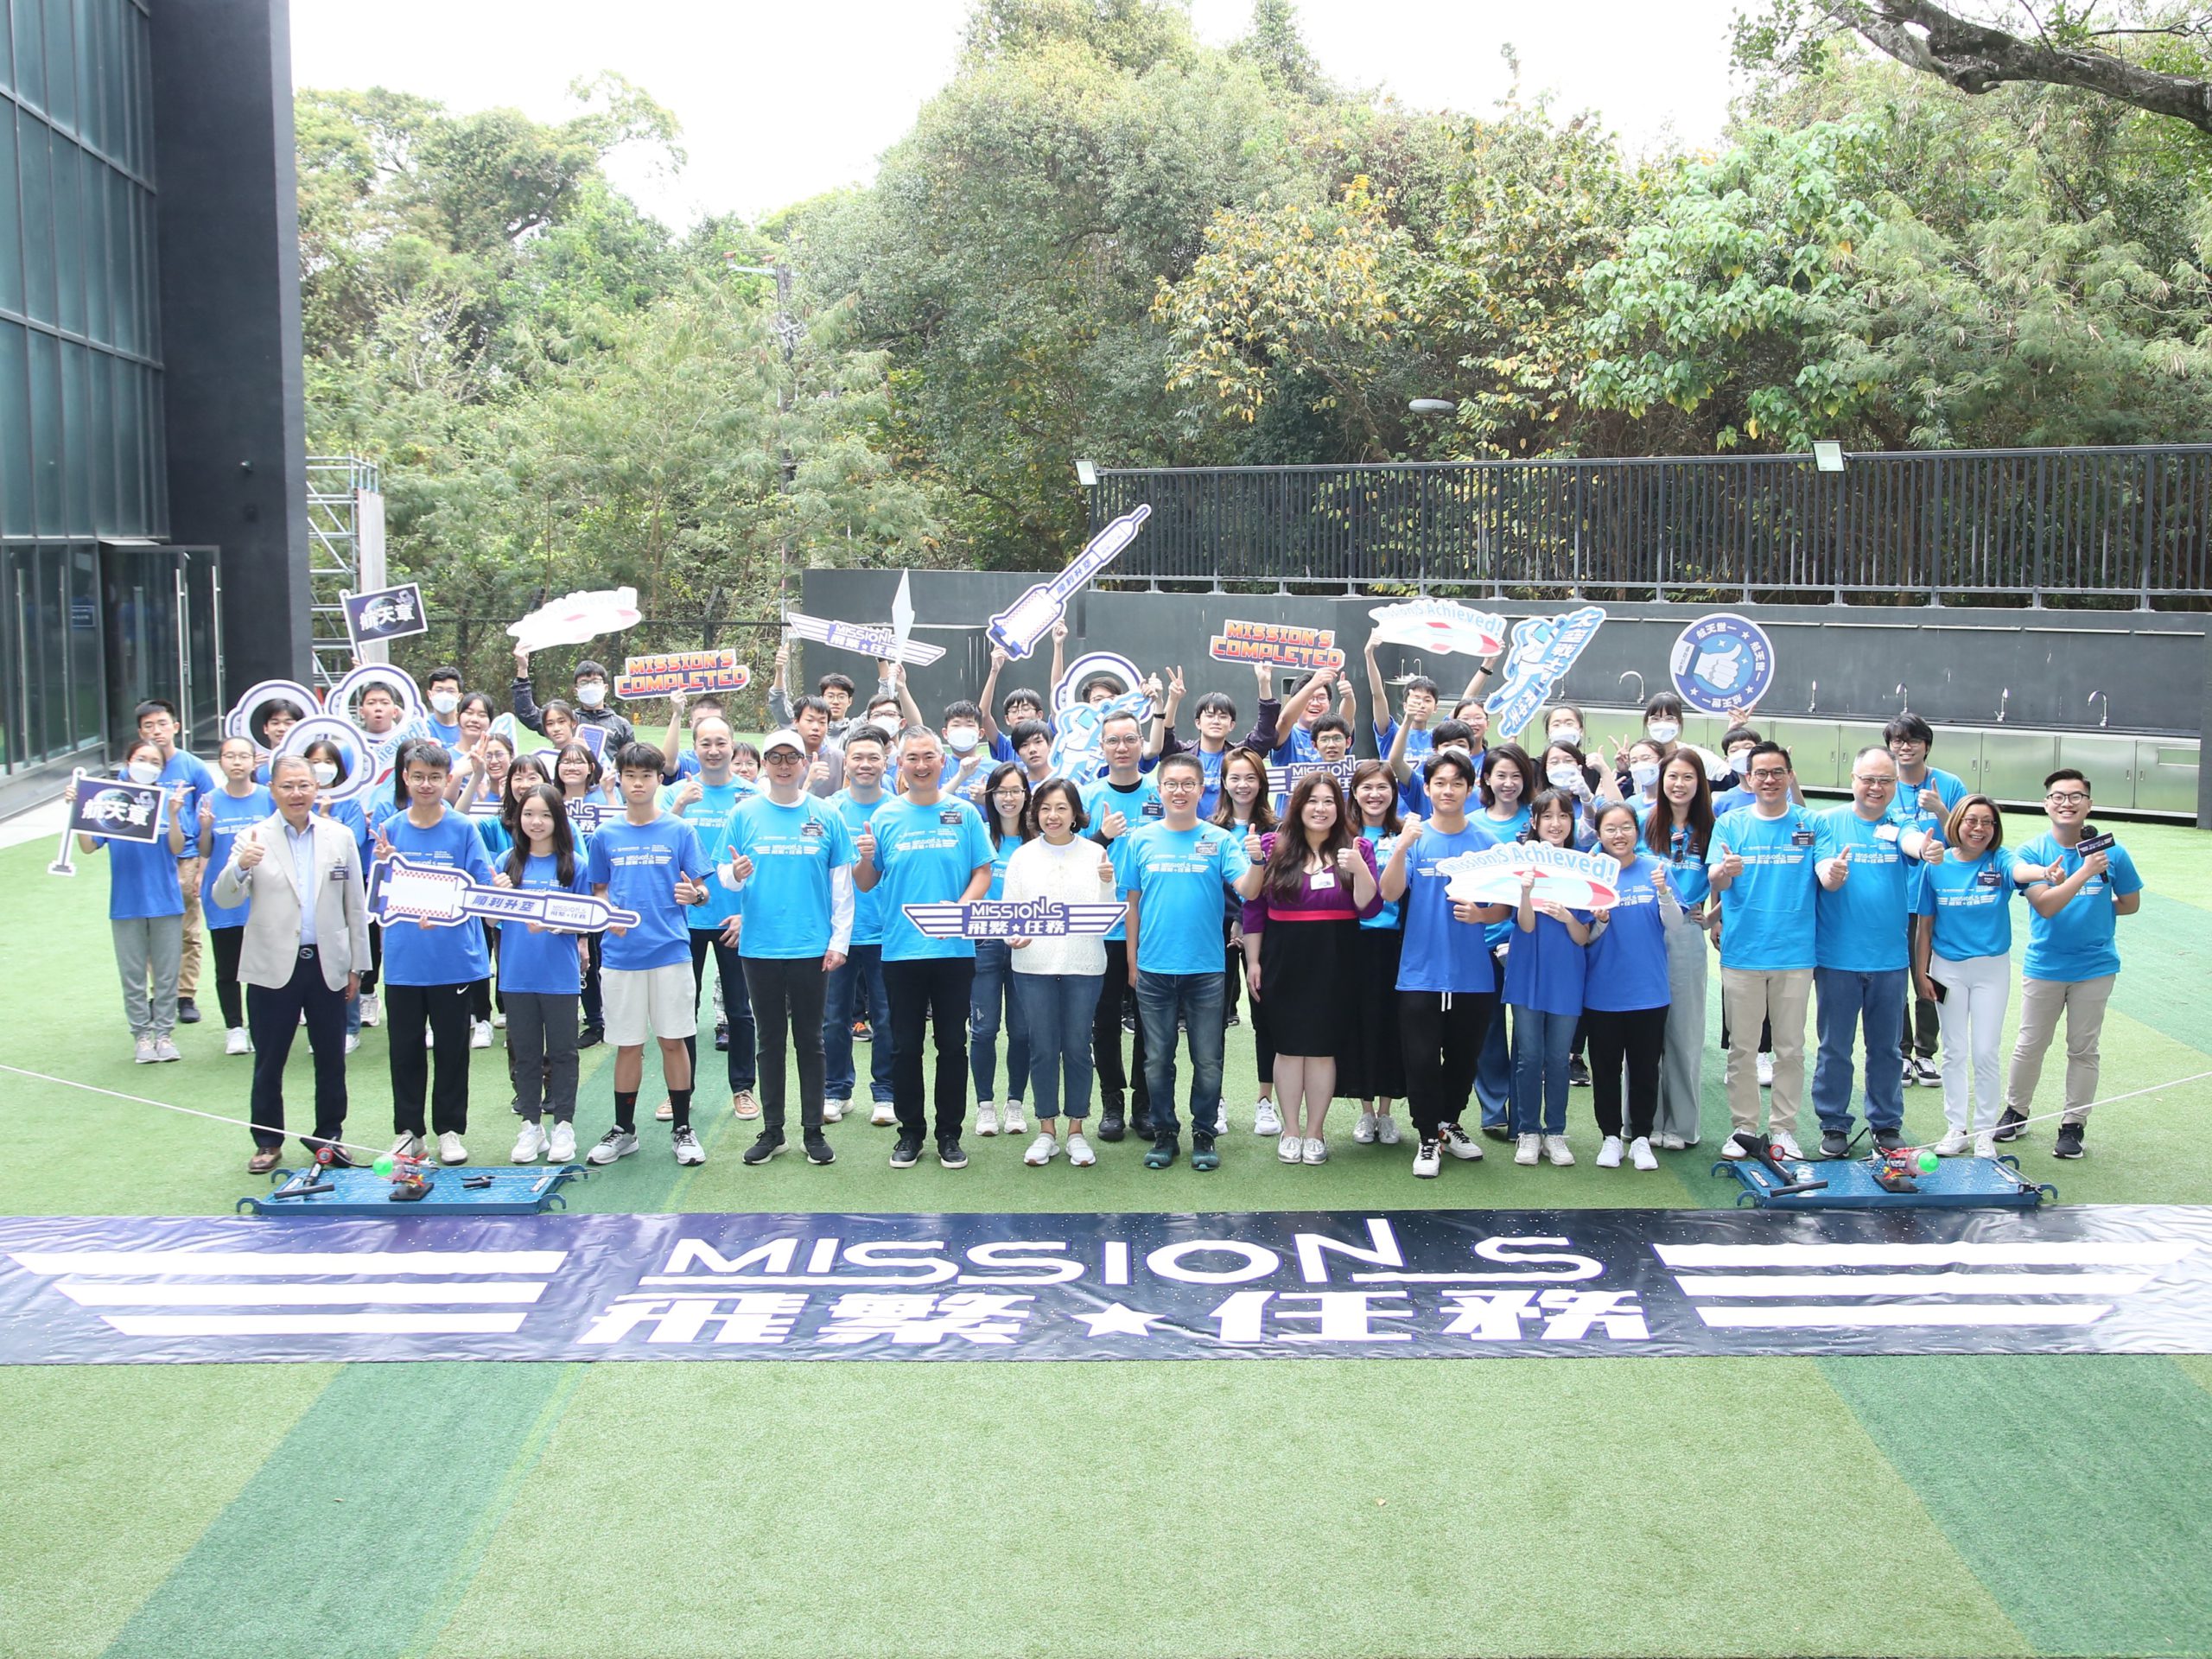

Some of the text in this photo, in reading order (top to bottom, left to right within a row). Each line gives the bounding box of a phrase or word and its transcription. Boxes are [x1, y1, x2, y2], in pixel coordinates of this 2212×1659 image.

[1427, 601, 1503, 637] Achieved!
[1212, 637, 1343, 668] COMPLETED
[618, 667, 748, 695] COMPLETED
[1514, 843, 1617, 883] Achieved!
